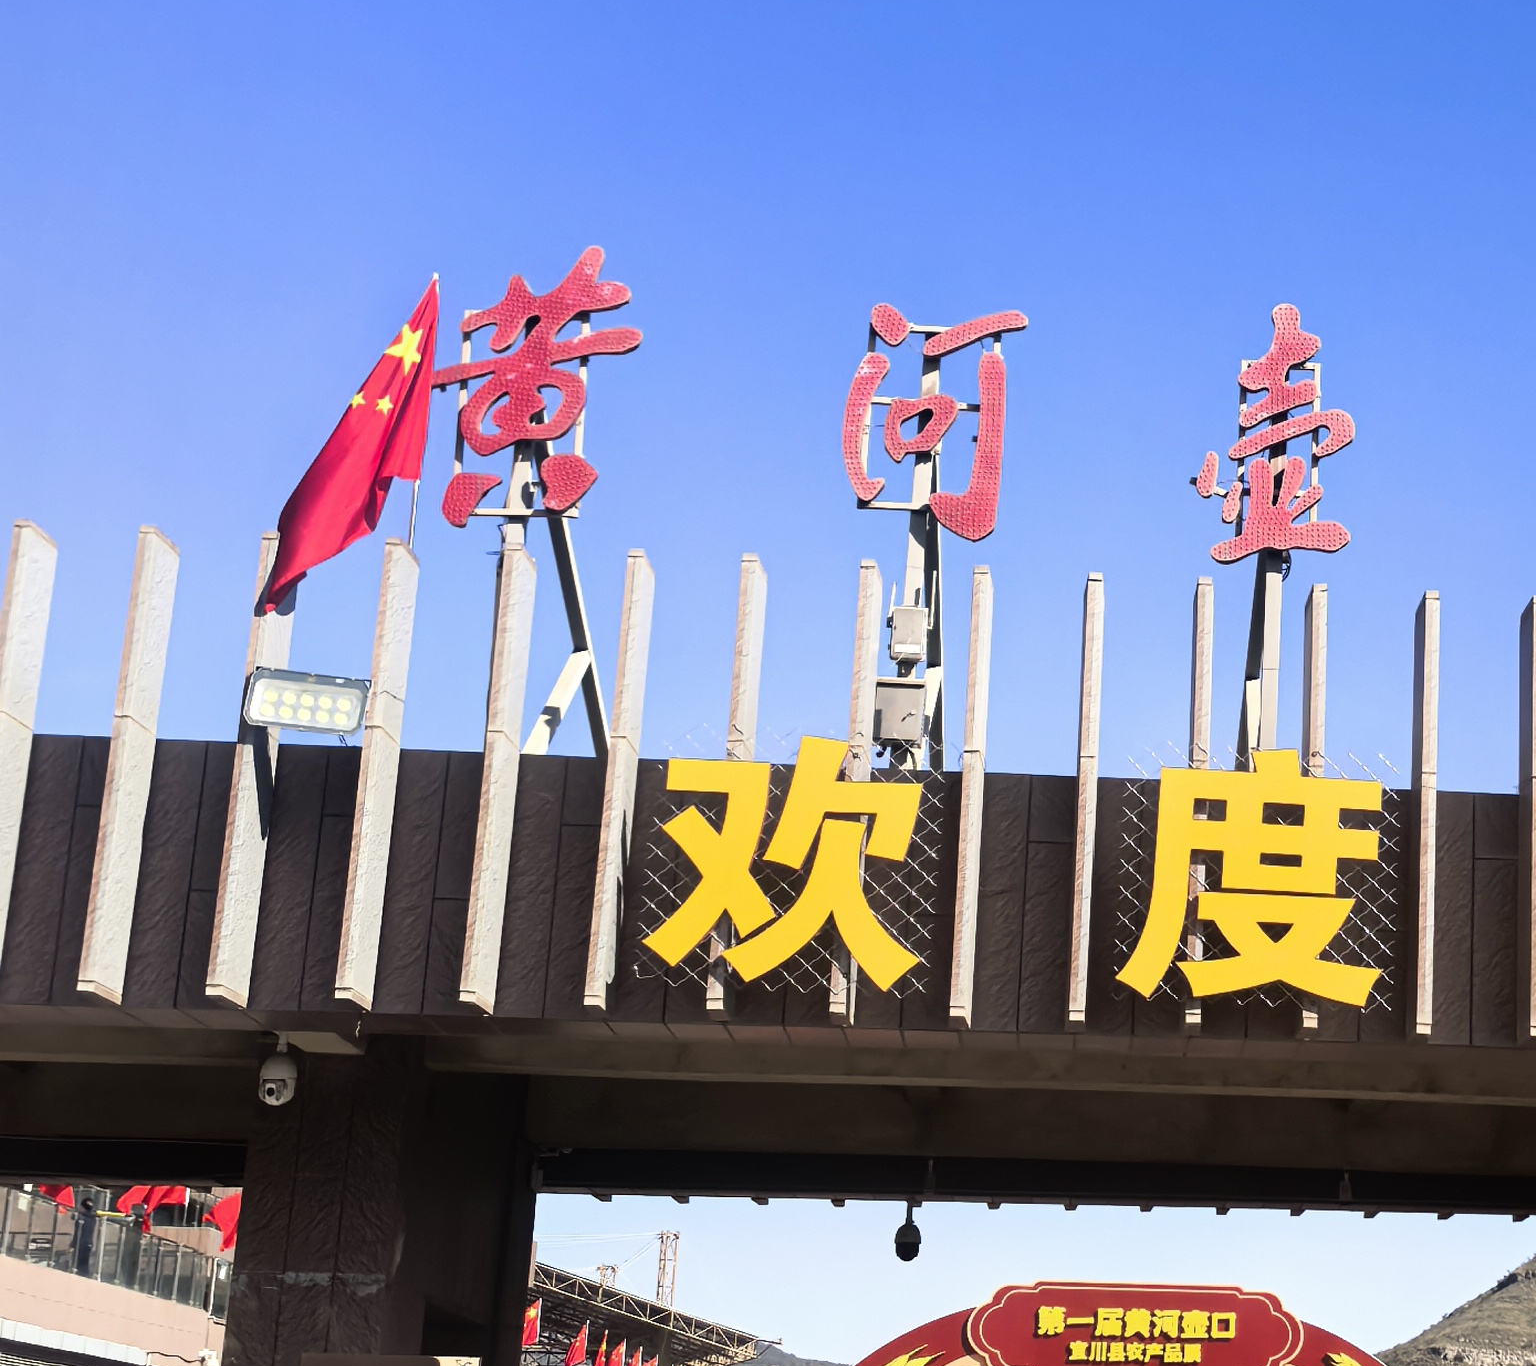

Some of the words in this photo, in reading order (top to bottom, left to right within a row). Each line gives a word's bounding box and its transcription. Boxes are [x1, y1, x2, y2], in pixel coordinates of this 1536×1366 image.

[1036, 1305, 1237, 1340] 第一届黄河壶口
